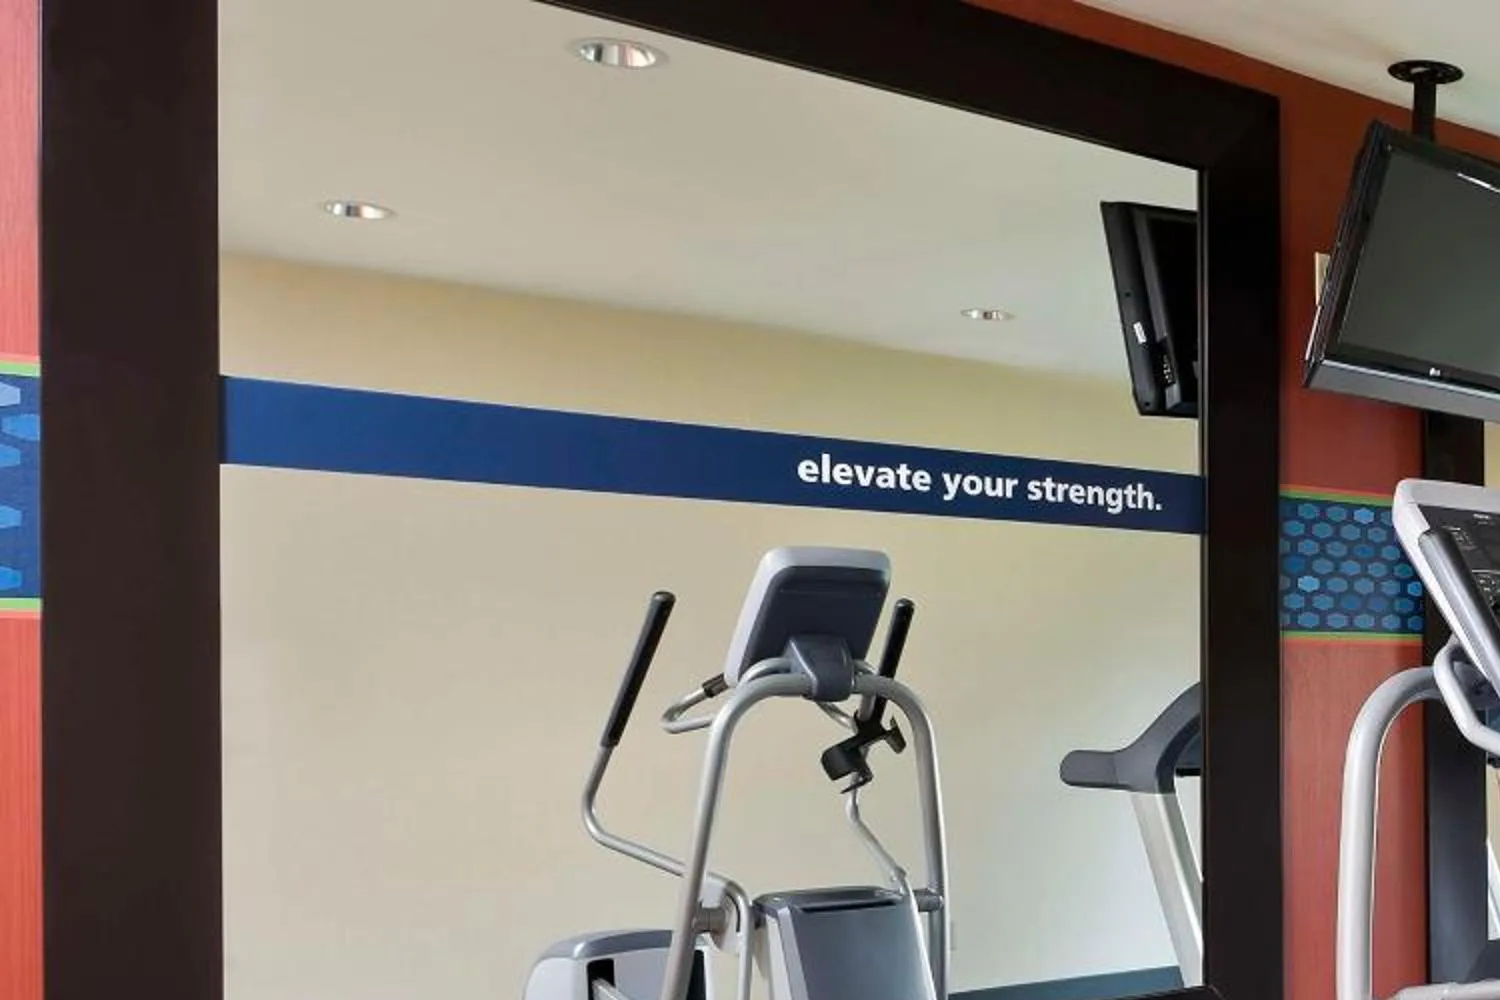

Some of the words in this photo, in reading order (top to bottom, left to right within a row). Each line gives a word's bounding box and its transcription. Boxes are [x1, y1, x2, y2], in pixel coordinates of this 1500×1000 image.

[797, 453, 932, 492] elevate
[943, 473, 1018, 501] your
[1027, 478, 1163, 513] strength.
